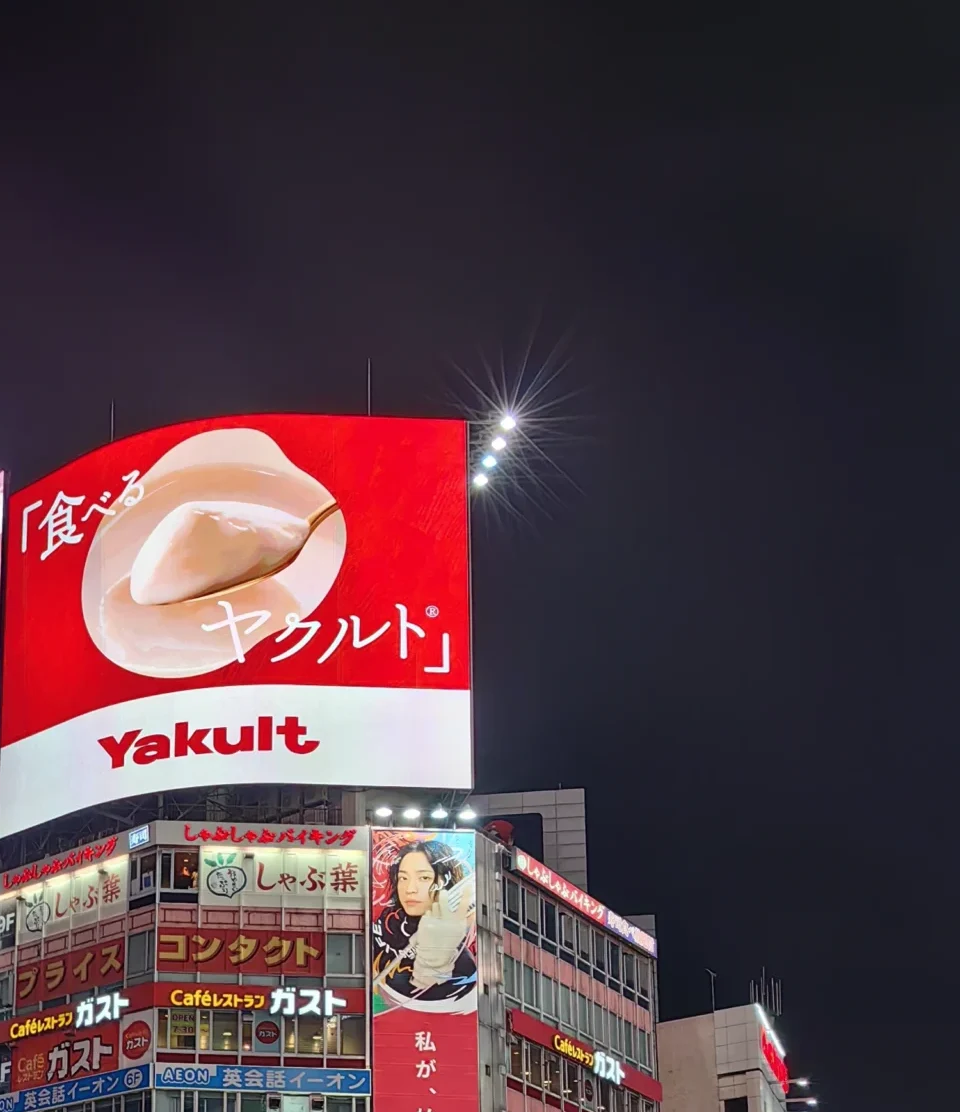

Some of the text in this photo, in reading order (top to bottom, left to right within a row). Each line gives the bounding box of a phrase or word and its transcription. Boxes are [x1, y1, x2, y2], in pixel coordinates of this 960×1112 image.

[21, 469, 145, 562] 「食べる
[97, 715, 321, 770] Yakult
[183, 823, 357, 846] しゃぶしゃぶバイキング
[2, 836, 118, 889] しゃぶしゃぶバイキング
[256, 862, 359, 894] しゃぶ葉
[54, 873, 122, 918] しゃぶ葉
[158, 932, 323, 968] コンタクト
[17, 943, 125, 1000] プライス
[9, 991, 130, 1040] Caféレストラン ガスト
[170, 986, 347, 1017] Caféレストラン ガスト
[126, 1036, 150, 1050] ガスト
[258, 1030, 278, 1039] ガスト
[17, 1053, 45, 1073] Café
[46, 1036, 113, 1082] ガスト
[593, 1051, 626, 1086] ガスト
[23, 1075, 119, 1111] 英会話イーオン
[125, 1072, 141, 1086] 6F
[161, 1066, 366, 1090] AEON 英会話イーオン
